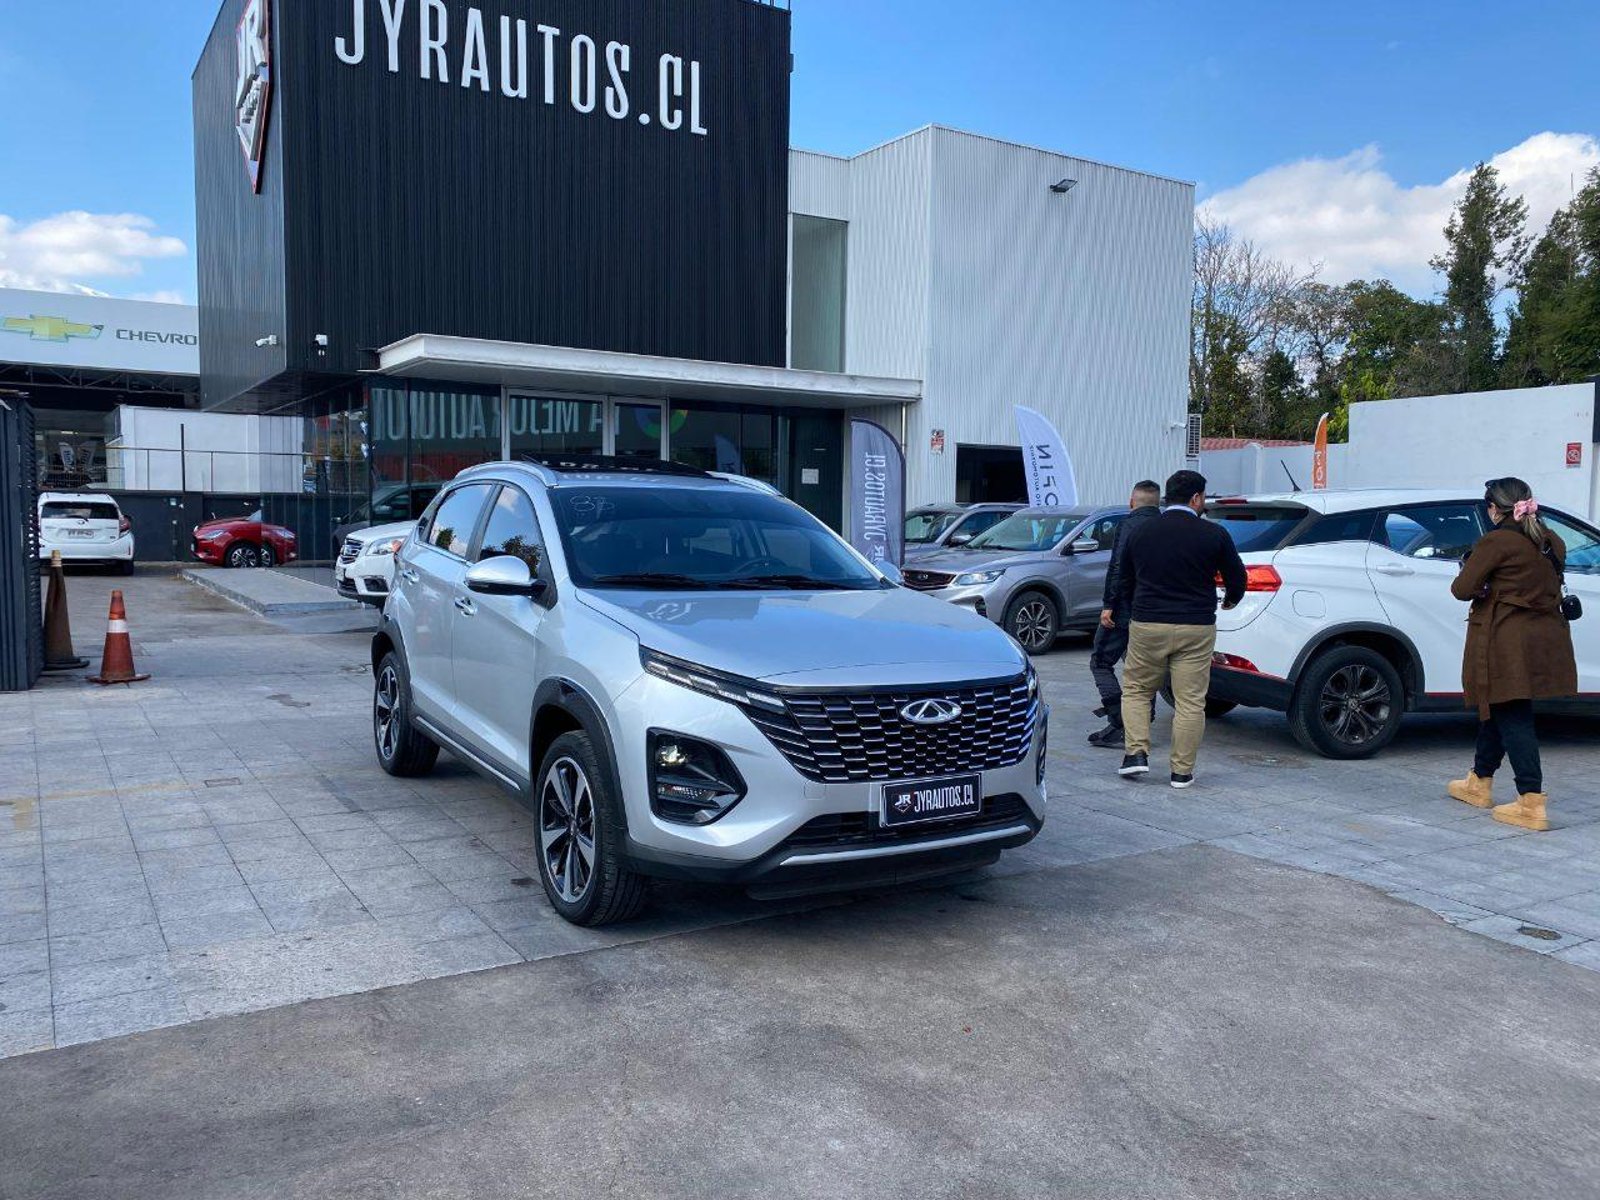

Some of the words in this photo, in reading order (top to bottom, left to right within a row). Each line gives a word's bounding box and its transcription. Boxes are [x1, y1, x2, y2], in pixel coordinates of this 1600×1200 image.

[335, 0, 707, 135] JYRAUTOS.CL
[894, 794, 912, 806] JR
[913, 783, 975, 812] JYRAUTOS.CL
